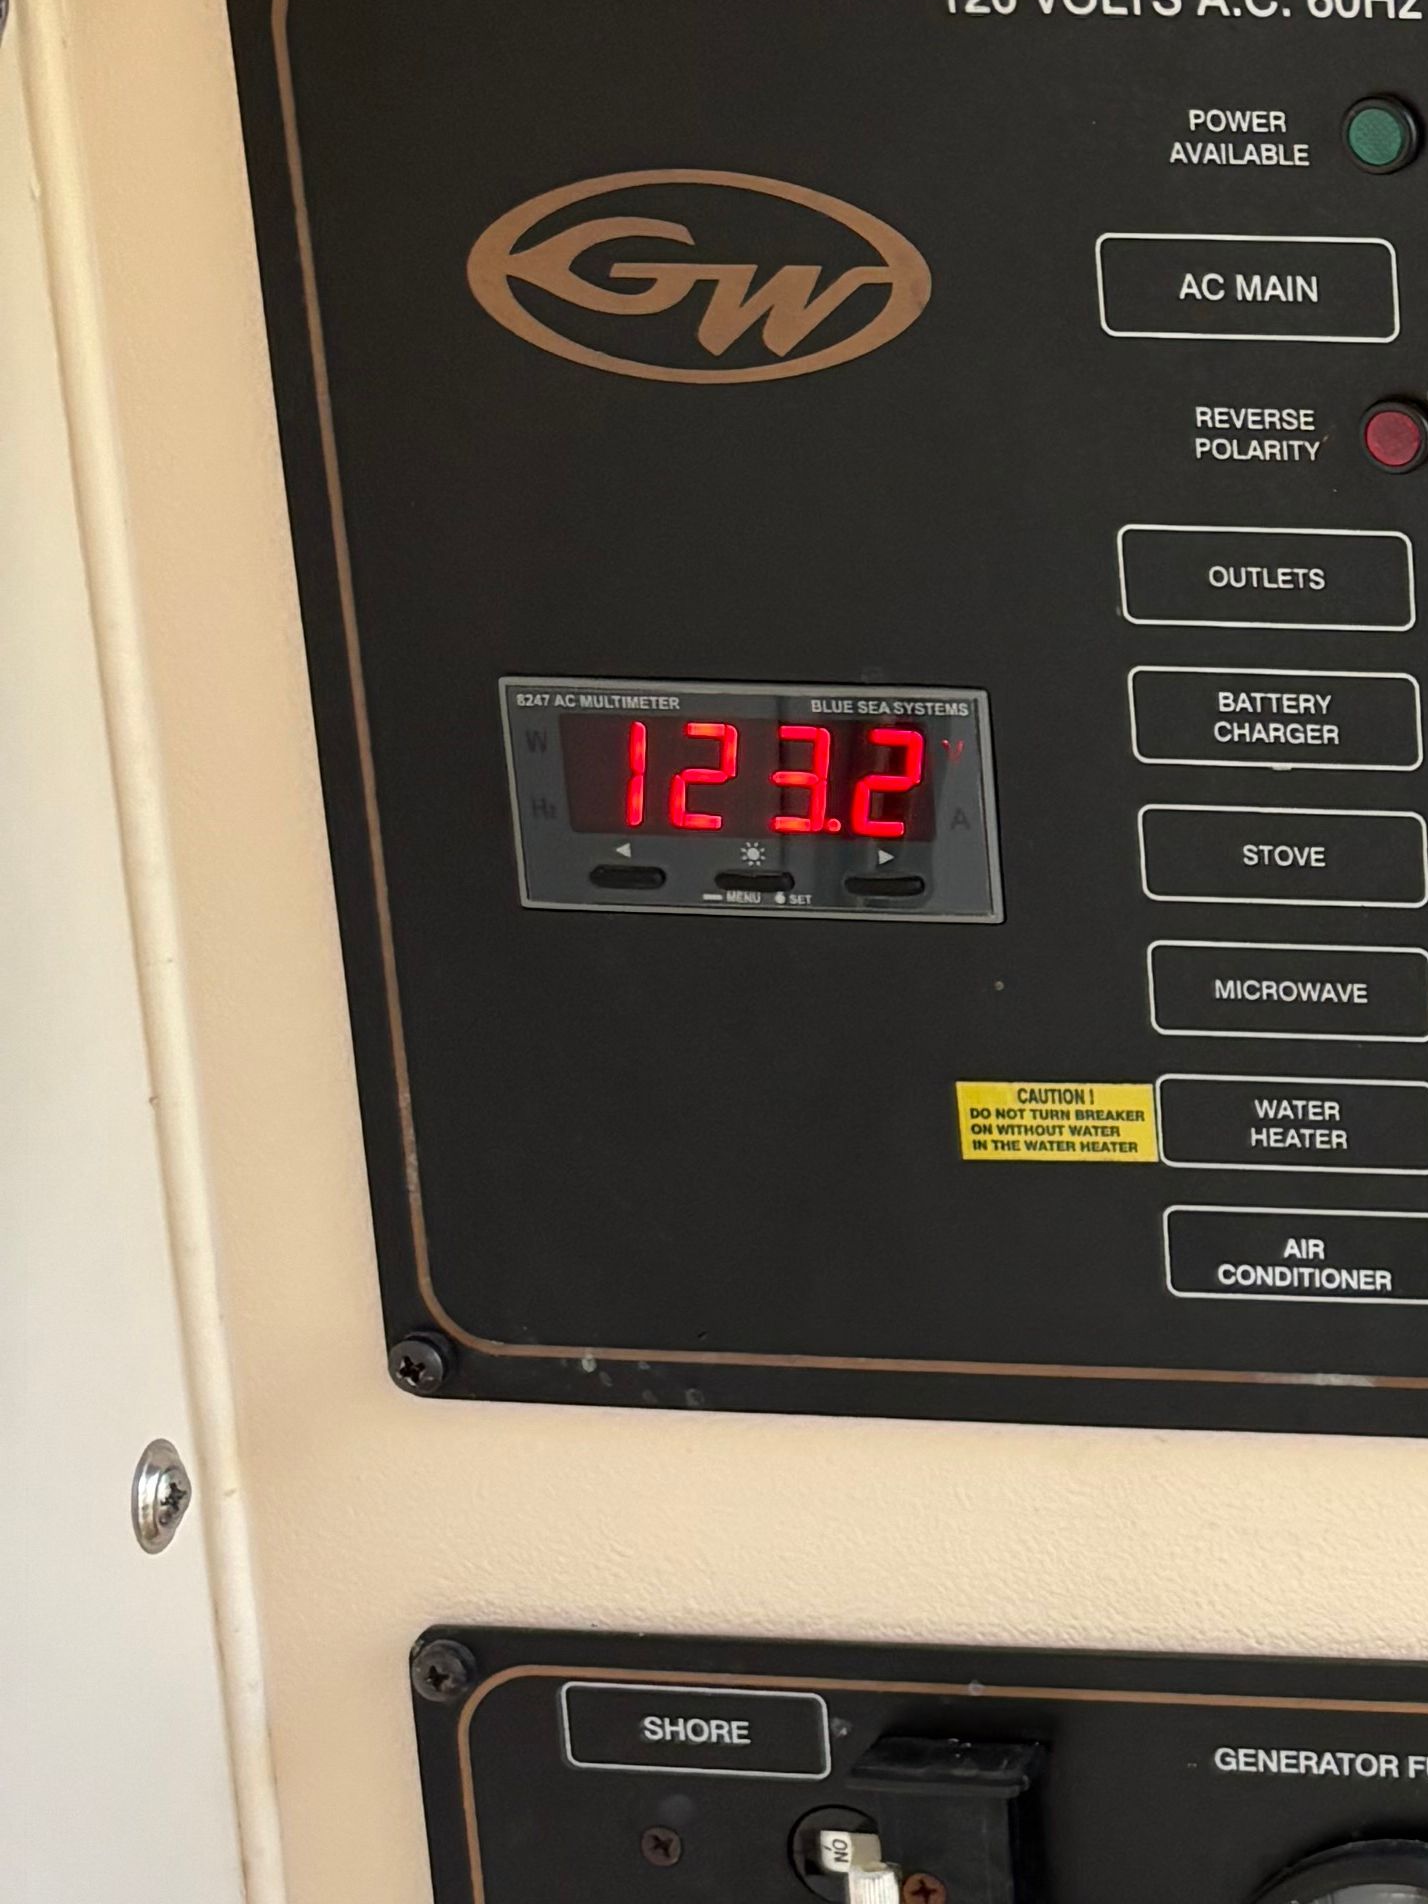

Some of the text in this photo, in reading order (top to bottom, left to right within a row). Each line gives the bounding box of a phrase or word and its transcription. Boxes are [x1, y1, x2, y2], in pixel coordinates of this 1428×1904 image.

[1189, 110, 1286, 132] POWER
[1170, 142, 1309, 165] AVAILABLE
[1180, 273, 1317, 302] AC MAIN
[1196, 407, 1314, 430] REVERSE
[1196, 438, 1319, 460] POLARITY
[1209, 566, 1324, 589] OUTLETS
[517, 694, 679, 709] 8247 AC MULTIMETER
[811, 700, 968, 716] BLUE SEA SYSTEMS
[1219, 692, 1331, 714] BATTERY
[1214, 721, 1338, 744] CHARGER
[625, 721, 924, 837] 123.2
[1243, 845, 1325, 866] STOVE
[1215, 980, 1367, 1003] MICROWAVE
[1017, 1088, 1085, 1104] CAUTION
[970, 1108, 1145, 1121] DO NOT TURN BREAKER
[1255, 1100, 1339, 1120] WATER
[971, 1124, 1120, 1137] ON WITHOUT WATER
[1251, 1128, 1347, 1148] HEATER
[973, 1140, 1137, 1153] IN THE WATER HEATER
[1284, 1239, 1324, 1259] AIR
[1218, 1264, 1391, 1290] CONDITIONER
[644, 1717, 750, 1744] SHORE
[1215, 1748, 1398, 1777] GENERATOR
